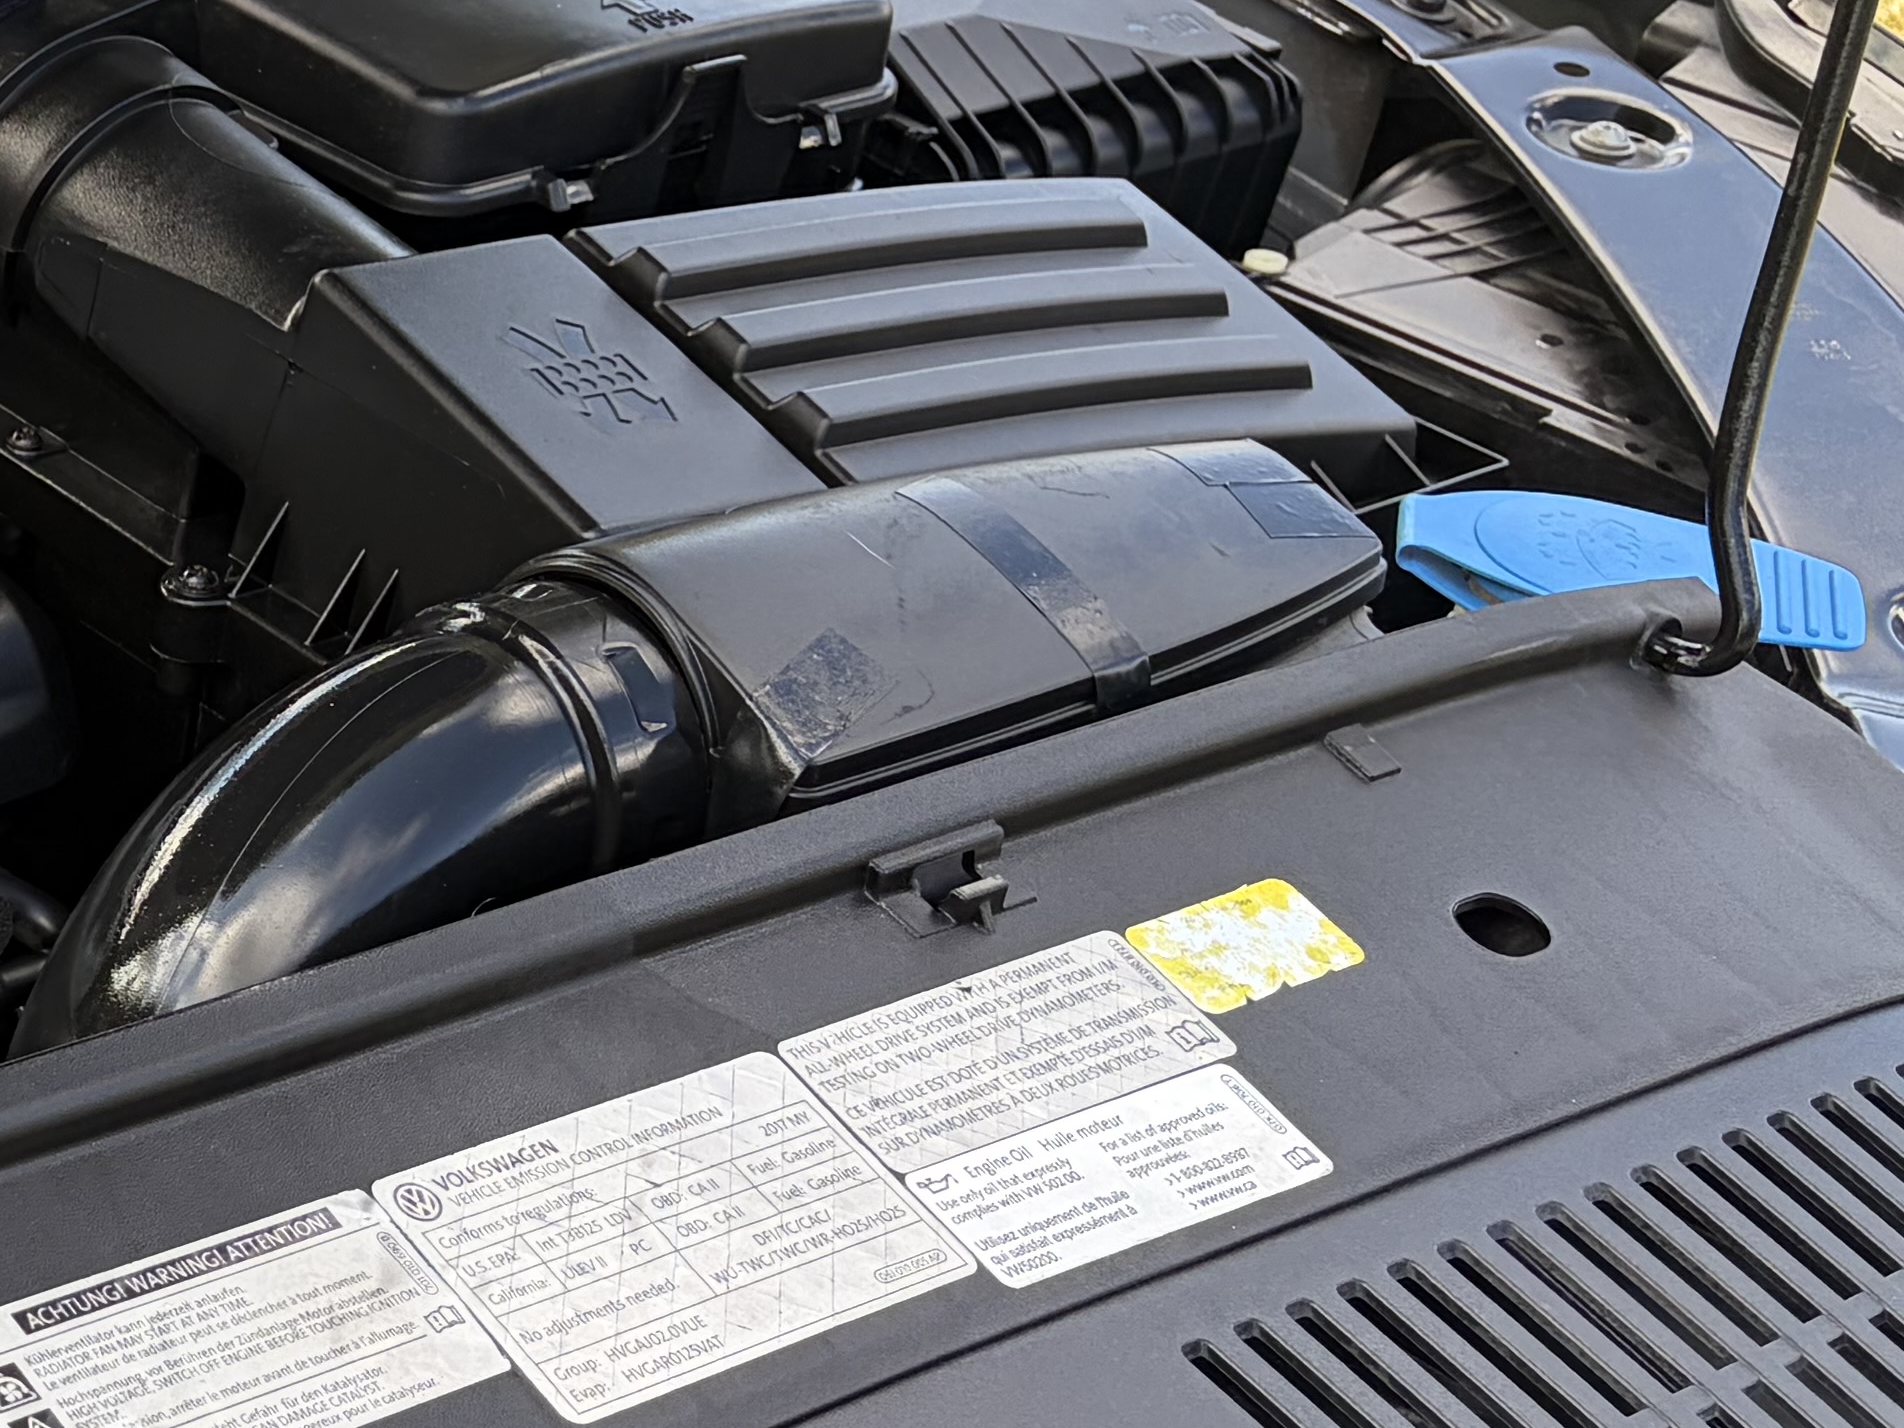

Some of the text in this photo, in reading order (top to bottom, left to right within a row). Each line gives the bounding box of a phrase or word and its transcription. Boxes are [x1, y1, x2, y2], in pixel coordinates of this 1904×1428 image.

[785, 1041, 822, 1061] THIS
[871, 1016, 891, 1030] IS
[885, 993, 957, 1027] EQUIPPED
[984, 976, 1003, 990] A
[997, 951, 1077, 986] PERMANENT
[800, 1043, 879, 1077] ALL-WHEEL
[873, 1028, 919, 1051] DRIVE
[913, 1011, 967, 1037] SYSTEM
[961, 1000, 998, 1020] AND
[993, 995, 1011, 1008] IS
[1005, 978, 1059, 1004] EXEMPT
[1054, 965, 1096, 986] FROM
[816, 977, 1125, 1094] TESTING ON TWO-WHEEL DRIVE DYNAMOMETERS.
[843, 1104, 869, 1121] CE
[923, 1074, 952, 1092] EST
[943, 1059, 987, 1083] DOTÉ
[1066, 1023, 1092, 1039] DE
[1085, 993, 1178, 1033] TRANSMISSION
[875, 1135, 910, 1155] SUR
[1018, 1081, 1060, 1103] DEUX
[1053, 1066, 1101, 1090] ROUES
[1094, 1043, 1163, 1075] MOTRICES.
[757, 1110, 814, 1137] 2017 MY
[856, 1101, 932, 1138] INTÉGRALE
[926, 1076, 1008, 1113] PERMANENT
[1002, 1070, 1025, 1085] ET
[962, 1112, 1126, 1181] Engine Oil Huile moteur
[429, 1138, 561, 1192] VOLKSWAGEN
[447, 1105, 724, 1208] VEHICLE EMISSION CONTROL INFORMATION
[436, 1218, 506, 1250] Conforms
[460, 1259, 492, 1277] U.S.
[534, 1236, 560, 1251] Int
[602, 1208, 635, 1227] LDV
[649, 1189, 689, 1210] OBD:
[686, 1182, 712, 1198] CA
[746, 1156, 781, 1175] Fuel:
[777, 1135, 839, 1164] Gasoline
[485, 1274, 552, 1306] California:
[559, 1258, 600, 1280] ULEV
[627, 1238, 653, 1255] PC
[674, 1217, 713, 1237] OBD:
[710, 1208, 737, 1225] CA
[771, 1183, 807, 1202] Fuel:
[803, 1162, 863, 1191] Gasoline
[21, 1213, 333, 1329] ACHTUNG! WARNING! ATTENTION!
[113, 1316, 147, 1336] kann
[141, 1300, 196, 1328] jederzeit
[190, 1282, 247, 1309] anlaufen.
[517, 1275, 681, 1344] No adjustments needed.
[31, 1350, 93, 1379] RADIATOR
[90, 1342, 118, 1359] FAN
[114, 1332, 145, 1350] MAY
[142, 1320, 181, 1340] START
[176, 1314, 196, 1328] AT
[192, 1305, 222, 1323] ANY
[64, 1401, 101, 1422] HIGH
[151, 1365, 201, 1391] SWITCH
[196, 1358, 223, 1374] OFF
[219, 1341, 268, 1366] ENGINE
[263, 1326, 310, 1350] BEFORE
[304, 1304, 371, 1335] TOUCHING
[365, 1286, 422, 1314] IGNITION
[551, 1355, 605, 1384] Group:
[568, 1379, 614, 1405] Evap:
